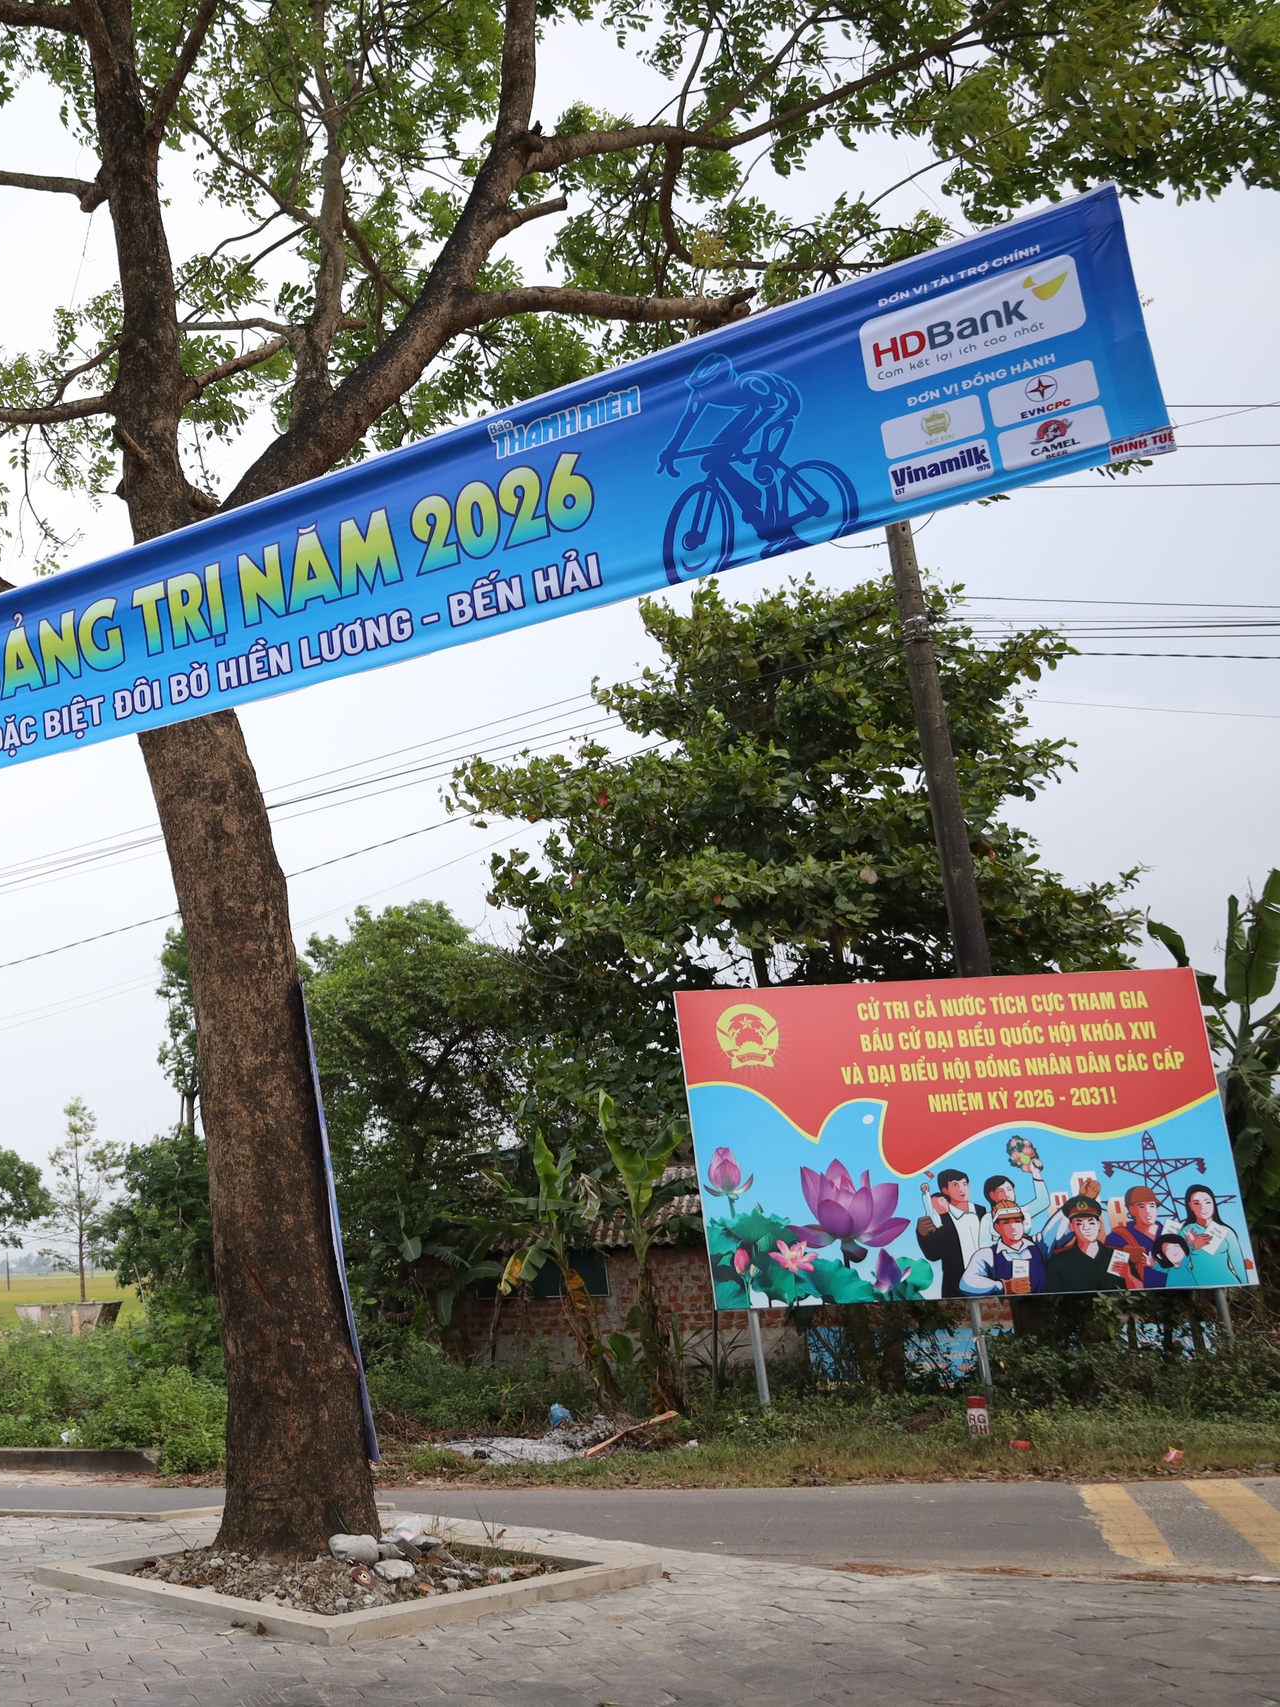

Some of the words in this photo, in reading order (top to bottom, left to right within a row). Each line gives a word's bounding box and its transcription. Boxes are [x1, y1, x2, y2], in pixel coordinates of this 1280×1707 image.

[878, 290, 910, 308] ĐƠN
[912, 284, 928, 295] VỊ
[930, 273, 955, 289] TÀI
[957, 261, 989, 280] TRỢ
[992, 244, 1041, 268] CHÍNH
[872, 299, 1028, 368] HDBank
[877, 367, 904, 381] Cam
[936, 349, 953, 363] lợi
[958, 343, 977, 355] ích
[983, 335, 1007, 347] cao
[1014, 321, 1045, 338] nhất
[907, 387, 940, 407] ĐƠN
[943, 382, 960, 396] VỊ
[961, 369, 1008, 390] ĐỒNG
[1010, 353, 1056, 376] HÀNH
[492, 408, 578, 459] THANH
[578, 386, 641, 432] NIÊN
[1020, 398, 1071, 420] EVNCPC
[487, 419, 513, 436] Báo
[925, 437, 939, 446] ABC
[941, 433, 955, 442] EDU
[1030, 438, 1080, 457] CAMEL
[1046, 449, 1068, 459] BEER
[1111, 438, 1147, 456] MINH
[891, 446, 989, 488] Vinamilk
[895, 487, 905, 495] EST
[131, 561, 228, 657] TRỊ
[237, 507, 404, 628] NĂM
[410, 452, 595, 577] 2026
[43, 694, 105, 739] BIỆT
[113, 676, 163, 721] ĐÔI
[169, 660, 210, 706] BỜ
[217, 638, 292, 691] HIỀN
[299, 607, 414, 669] LƯƠNG
[421, 611, 440, 626] -
[448, 568, 523, 627] BẾN
[533, 550, 605, 602] HẢI
[856, 996, 880, 1021] CỬ
[883, 1001, 910, 1020] TRI
[913, 994, 938, 1018] CẢ
[940, 994, 986, 1017] NƯỚC
[989, 993, 1028, 1014] TÍCH
[1031, 992, 1066, 1016] CỰC
[1067, 991, 1116, 1011] THAM
[1119, 990, 1148, 1009] GIA
[859, 1027, 894, 1052] BẦU
[898, 1025, 921, 1050] CỬ
[925, 1030, 954, 1052] ĐẠI
[957, 1021, 996, 1047] BIỂU
[999, 1019, 1045, 1047] QUỐC
[1047, 1021, 1077, 1047] HỘI
[1080, 1019, 1126, 1041] KHÓA
[1128, 1021, 1157, 1040] XVI
[840, 1062, 864, 1085] VÀ
[867, 1064, 896, 1087] ĐẠI
[899, 1055, 939, 1081] BIỂU
[942, 1057, 971, 1084] HỘI
[974, 1053, 1022, 1078] ĐỒNG
[1024, 1053, 1073, 1076] NHÂN
[1075, 1051, 1112, 1073] DÂN
[1114, 1050, 1149, 1072] CÁC
[1152, 1045, 1185, 1070] CẤP
[927, 1088, 984, 1115] NHIỆM
[987, 1087, 1008, 1110] KỲ
[1014, 1088, 1055, 1108] 2026
[1070, 1086, 1117, 1106] 2031!
[969, 1414, 986, 1425] RG
